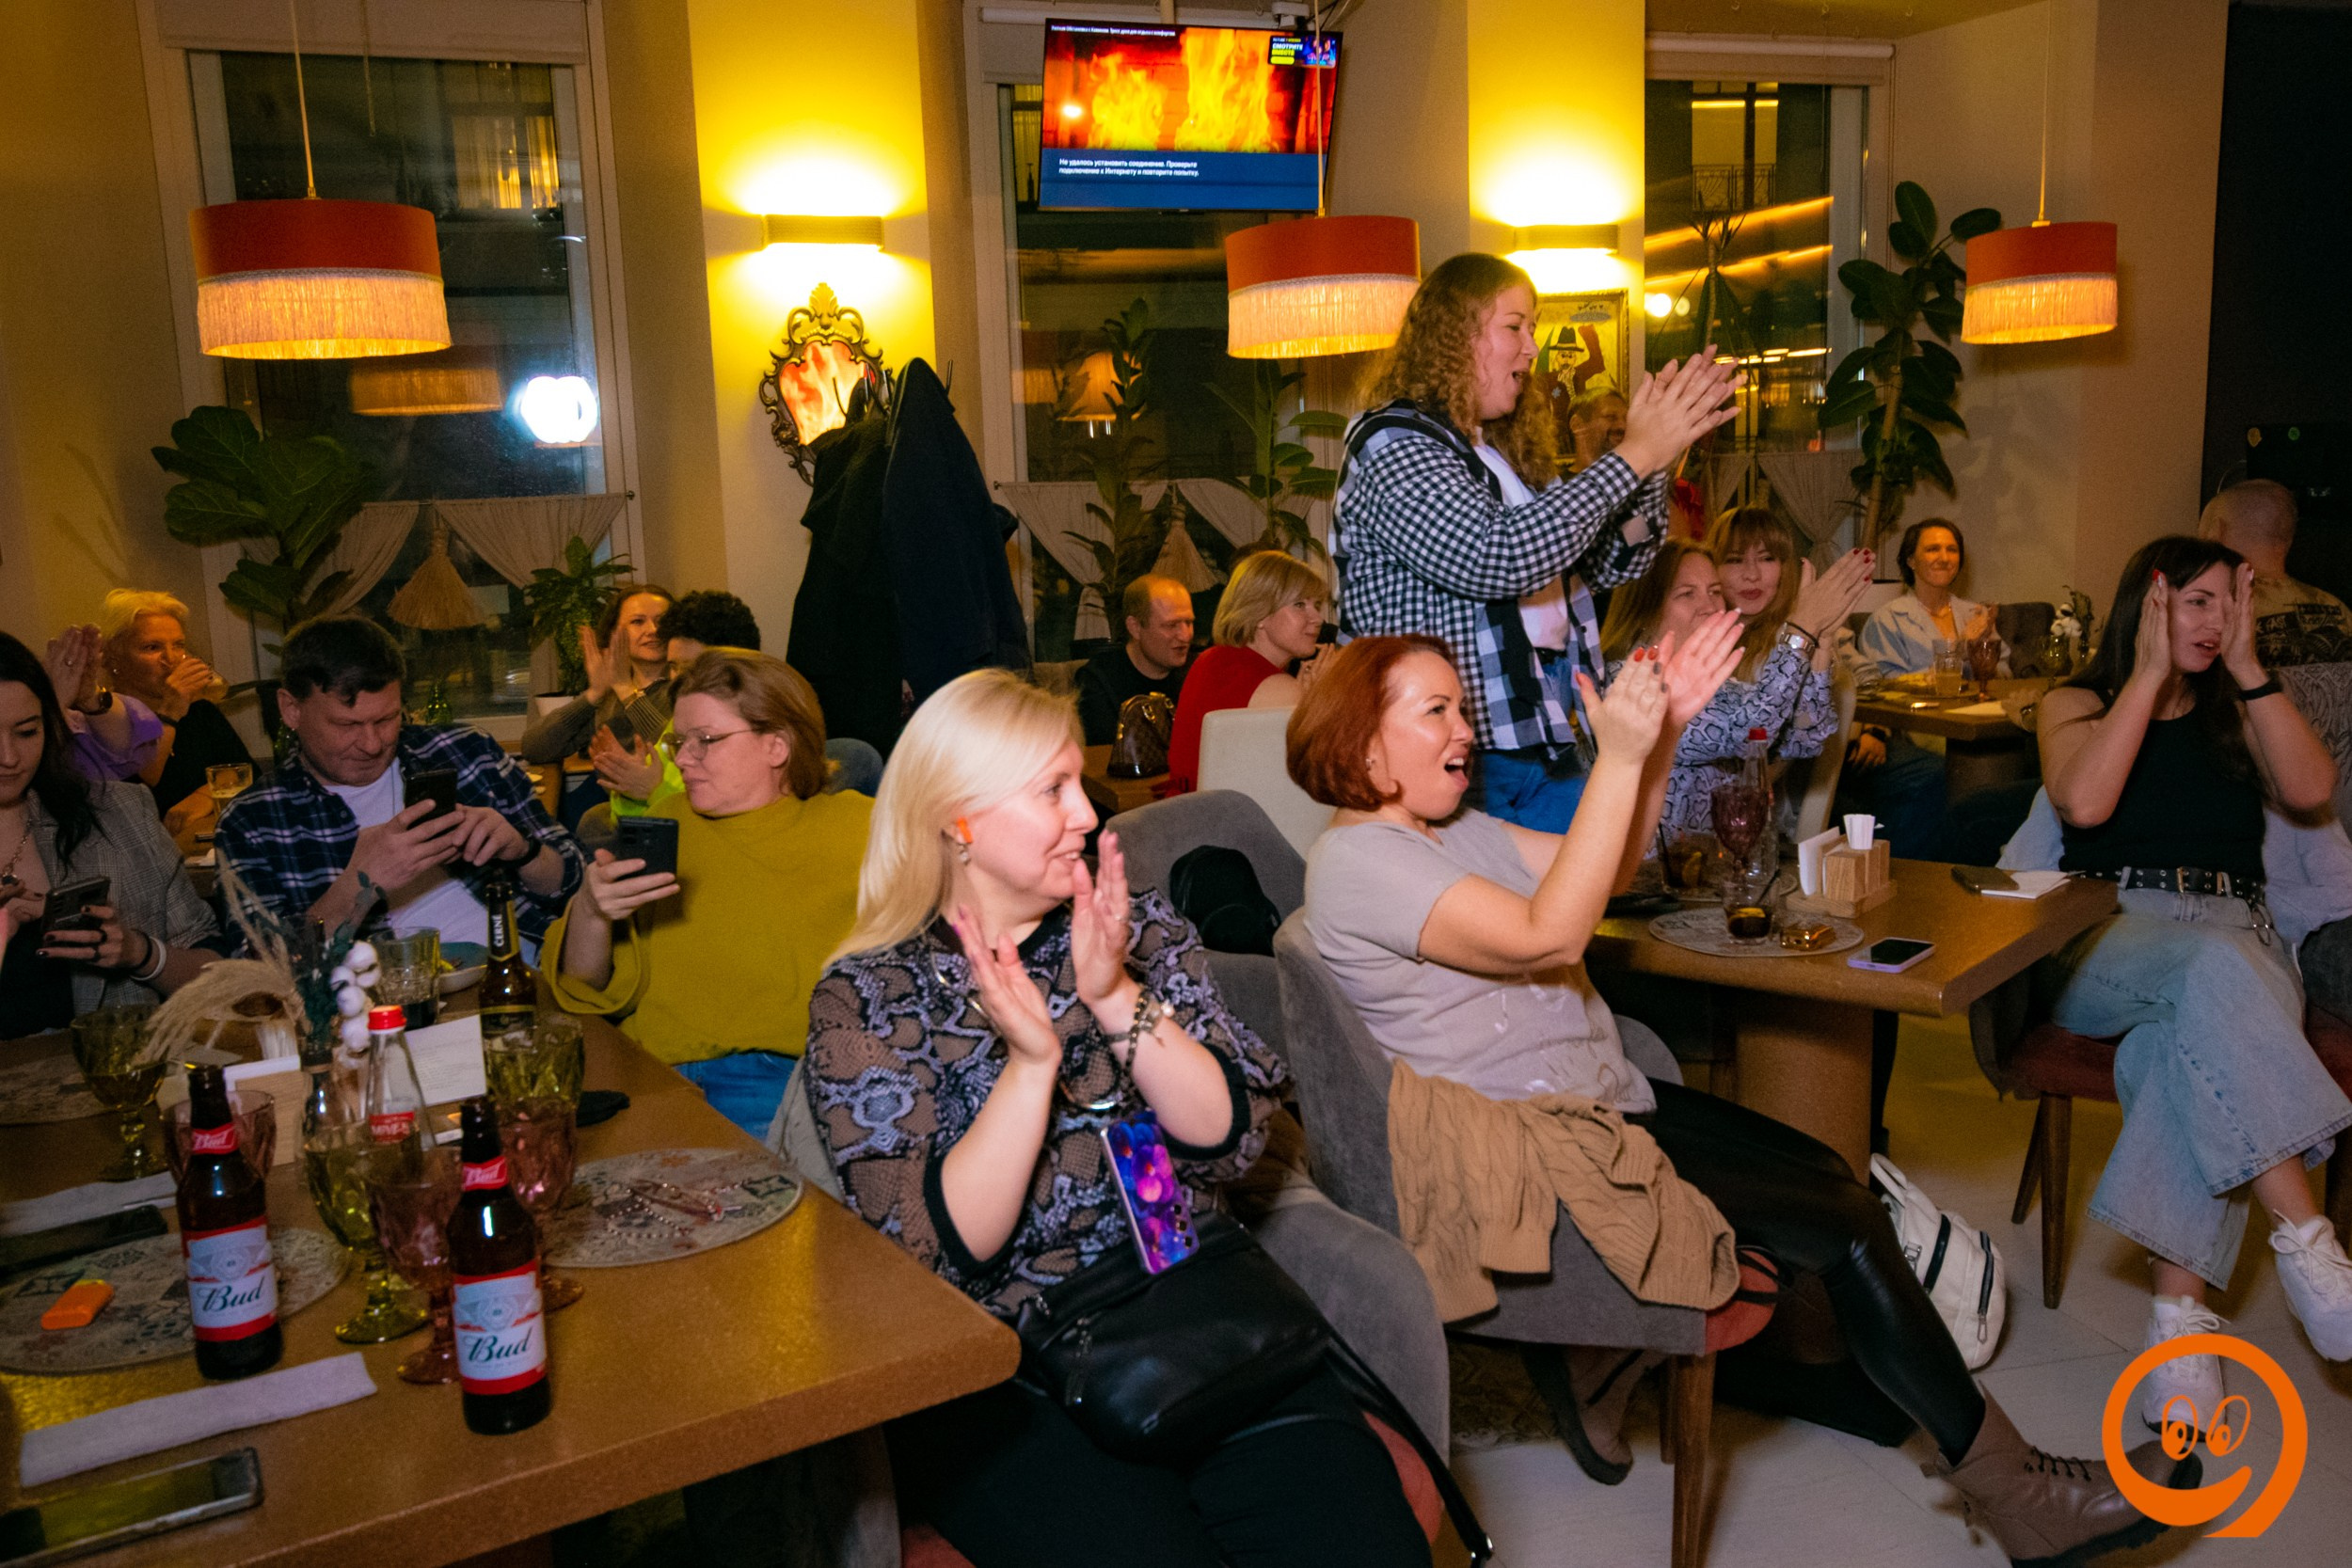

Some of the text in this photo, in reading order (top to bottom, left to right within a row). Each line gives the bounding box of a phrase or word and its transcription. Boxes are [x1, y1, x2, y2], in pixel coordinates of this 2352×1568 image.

[1094, 159, 1127, 167] установить
[1167, 160, 1198, 168] Проверьте
[1105, 167, 1136, 177] Интернету
[492, 913, 504, 947] ČERNÉ
[194, 1131, 230, 1150] Bud
[196, 1275, 265, 1312] Bud
[463, 1326, 533, 1363] Bud
